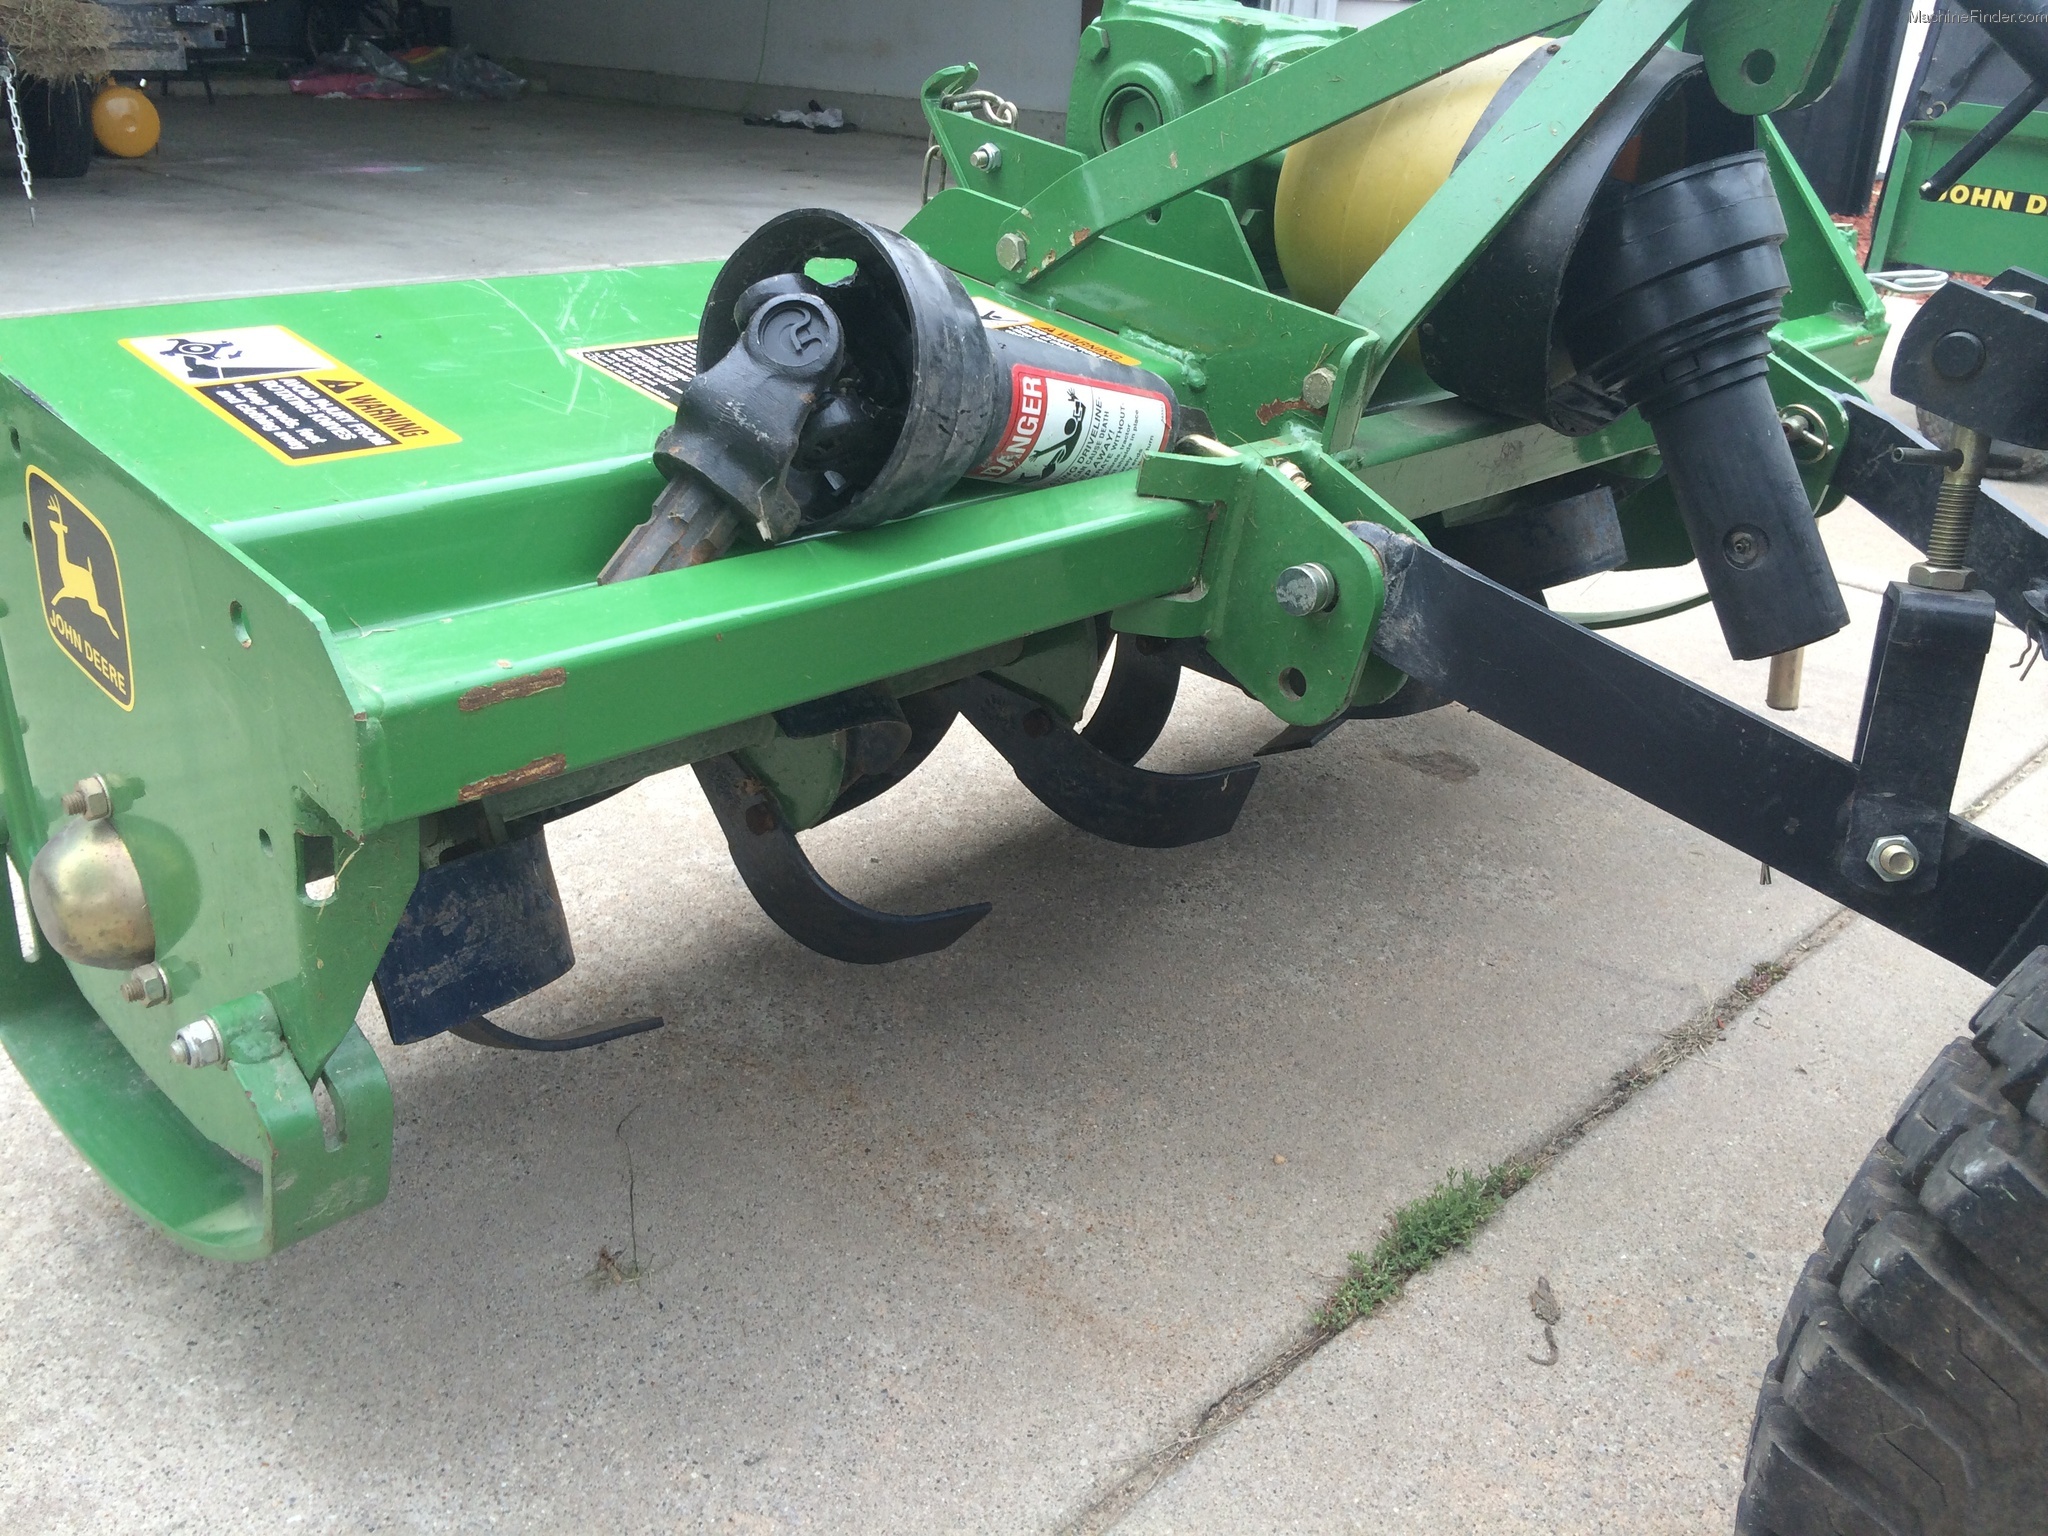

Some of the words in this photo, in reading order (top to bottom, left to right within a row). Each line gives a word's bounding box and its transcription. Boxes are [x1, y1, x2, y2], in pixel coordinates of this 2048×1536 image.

[2025, 194, 2048, 214] D
[258, 380, 319, 414] ROTATING
[307, 413, 358, 440] KNIVES
[278, 378, 320, 399] AVOID
[310, 398, 360, 424] INJURY
[347, 423, 392, 446] FROM
[345, 394, 430, 438] WARNING
[980, 375, 1043, 477] DANGER
[1098, 411, 1110, 439] DEATH
[1093, 429, 1115, 469] AWAY!
[1119, 424, 1132, 450] tractor
[50, 608, 84, 654] JOHN
[83, 640, 127, 696] DEERE
